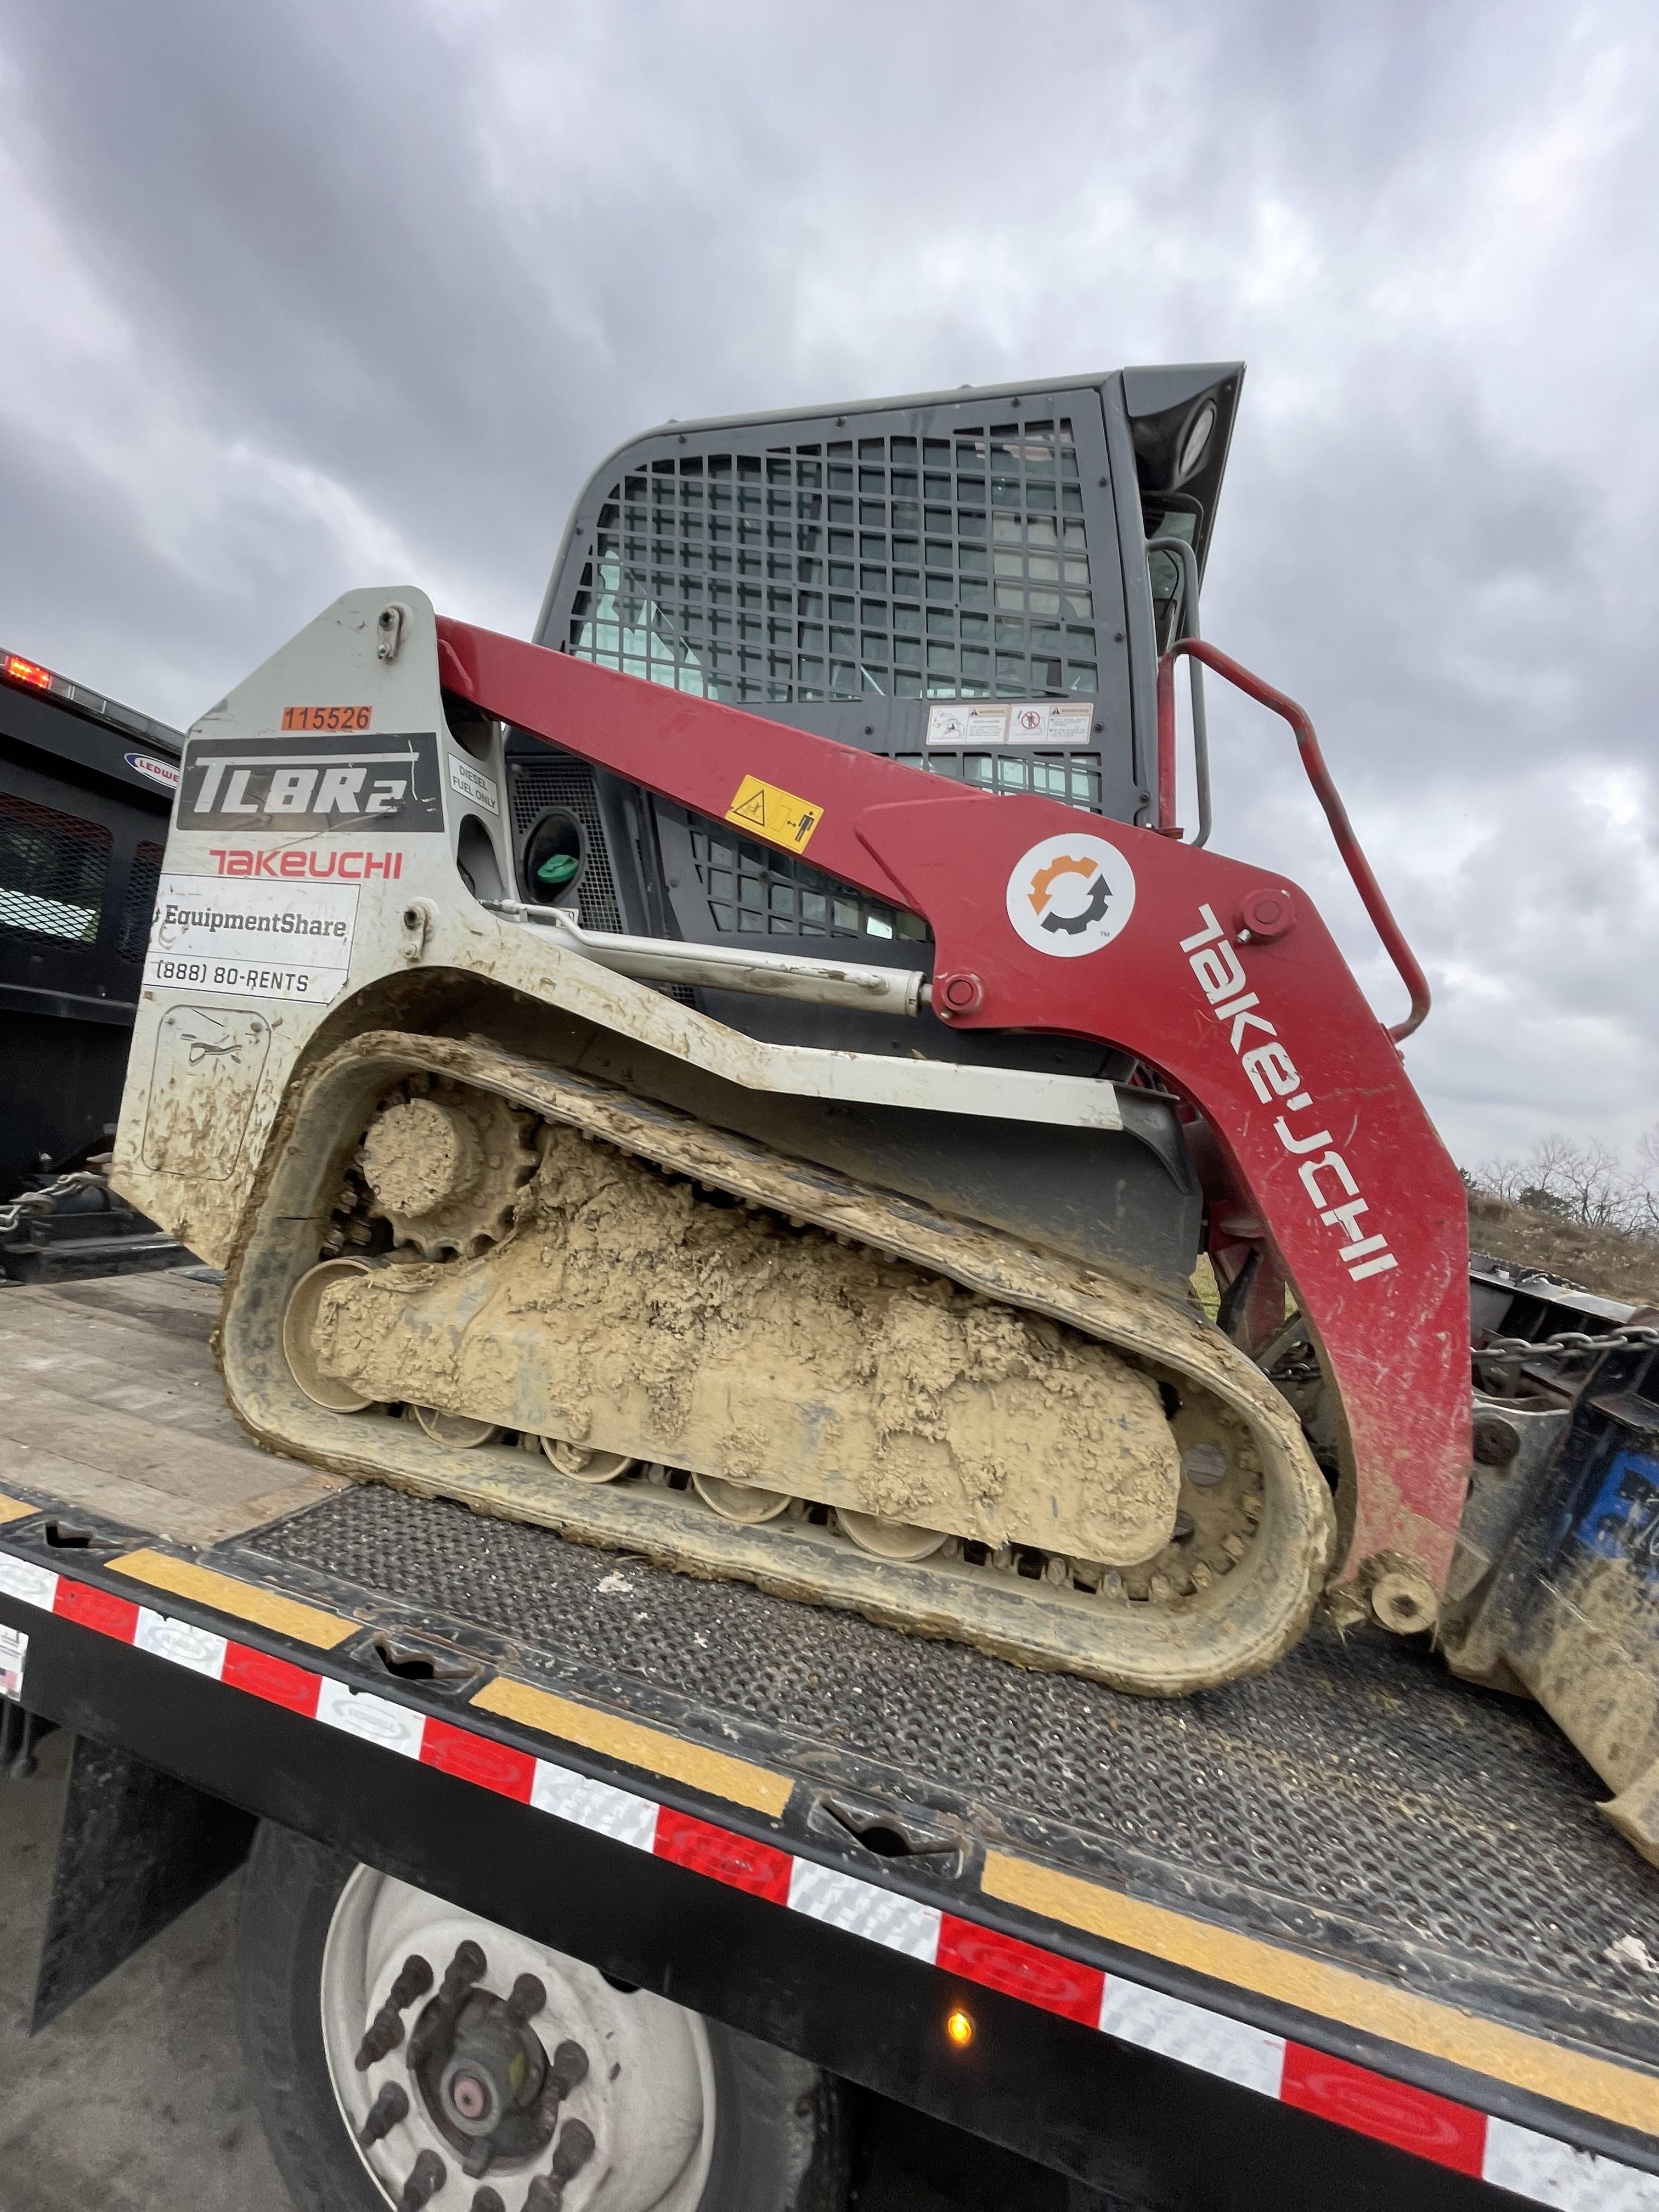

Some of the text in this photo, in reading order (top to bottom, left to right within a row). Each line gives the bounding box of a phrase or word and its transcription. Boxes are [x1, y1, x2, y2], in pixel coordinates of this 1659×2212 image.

[285, 706, 370, 730] 115526
[194, 752, 420, 814] TL8R2
[452, 775, 496, 809] FUEL ONLY
[459, 764, 488, 791] DIESEL
[209, 849, 403, 879] TAKEUCHI
[165, 904, 347, 938] EquipmentShare
[156, 960, 308, 992] (888) 80-RENTS
